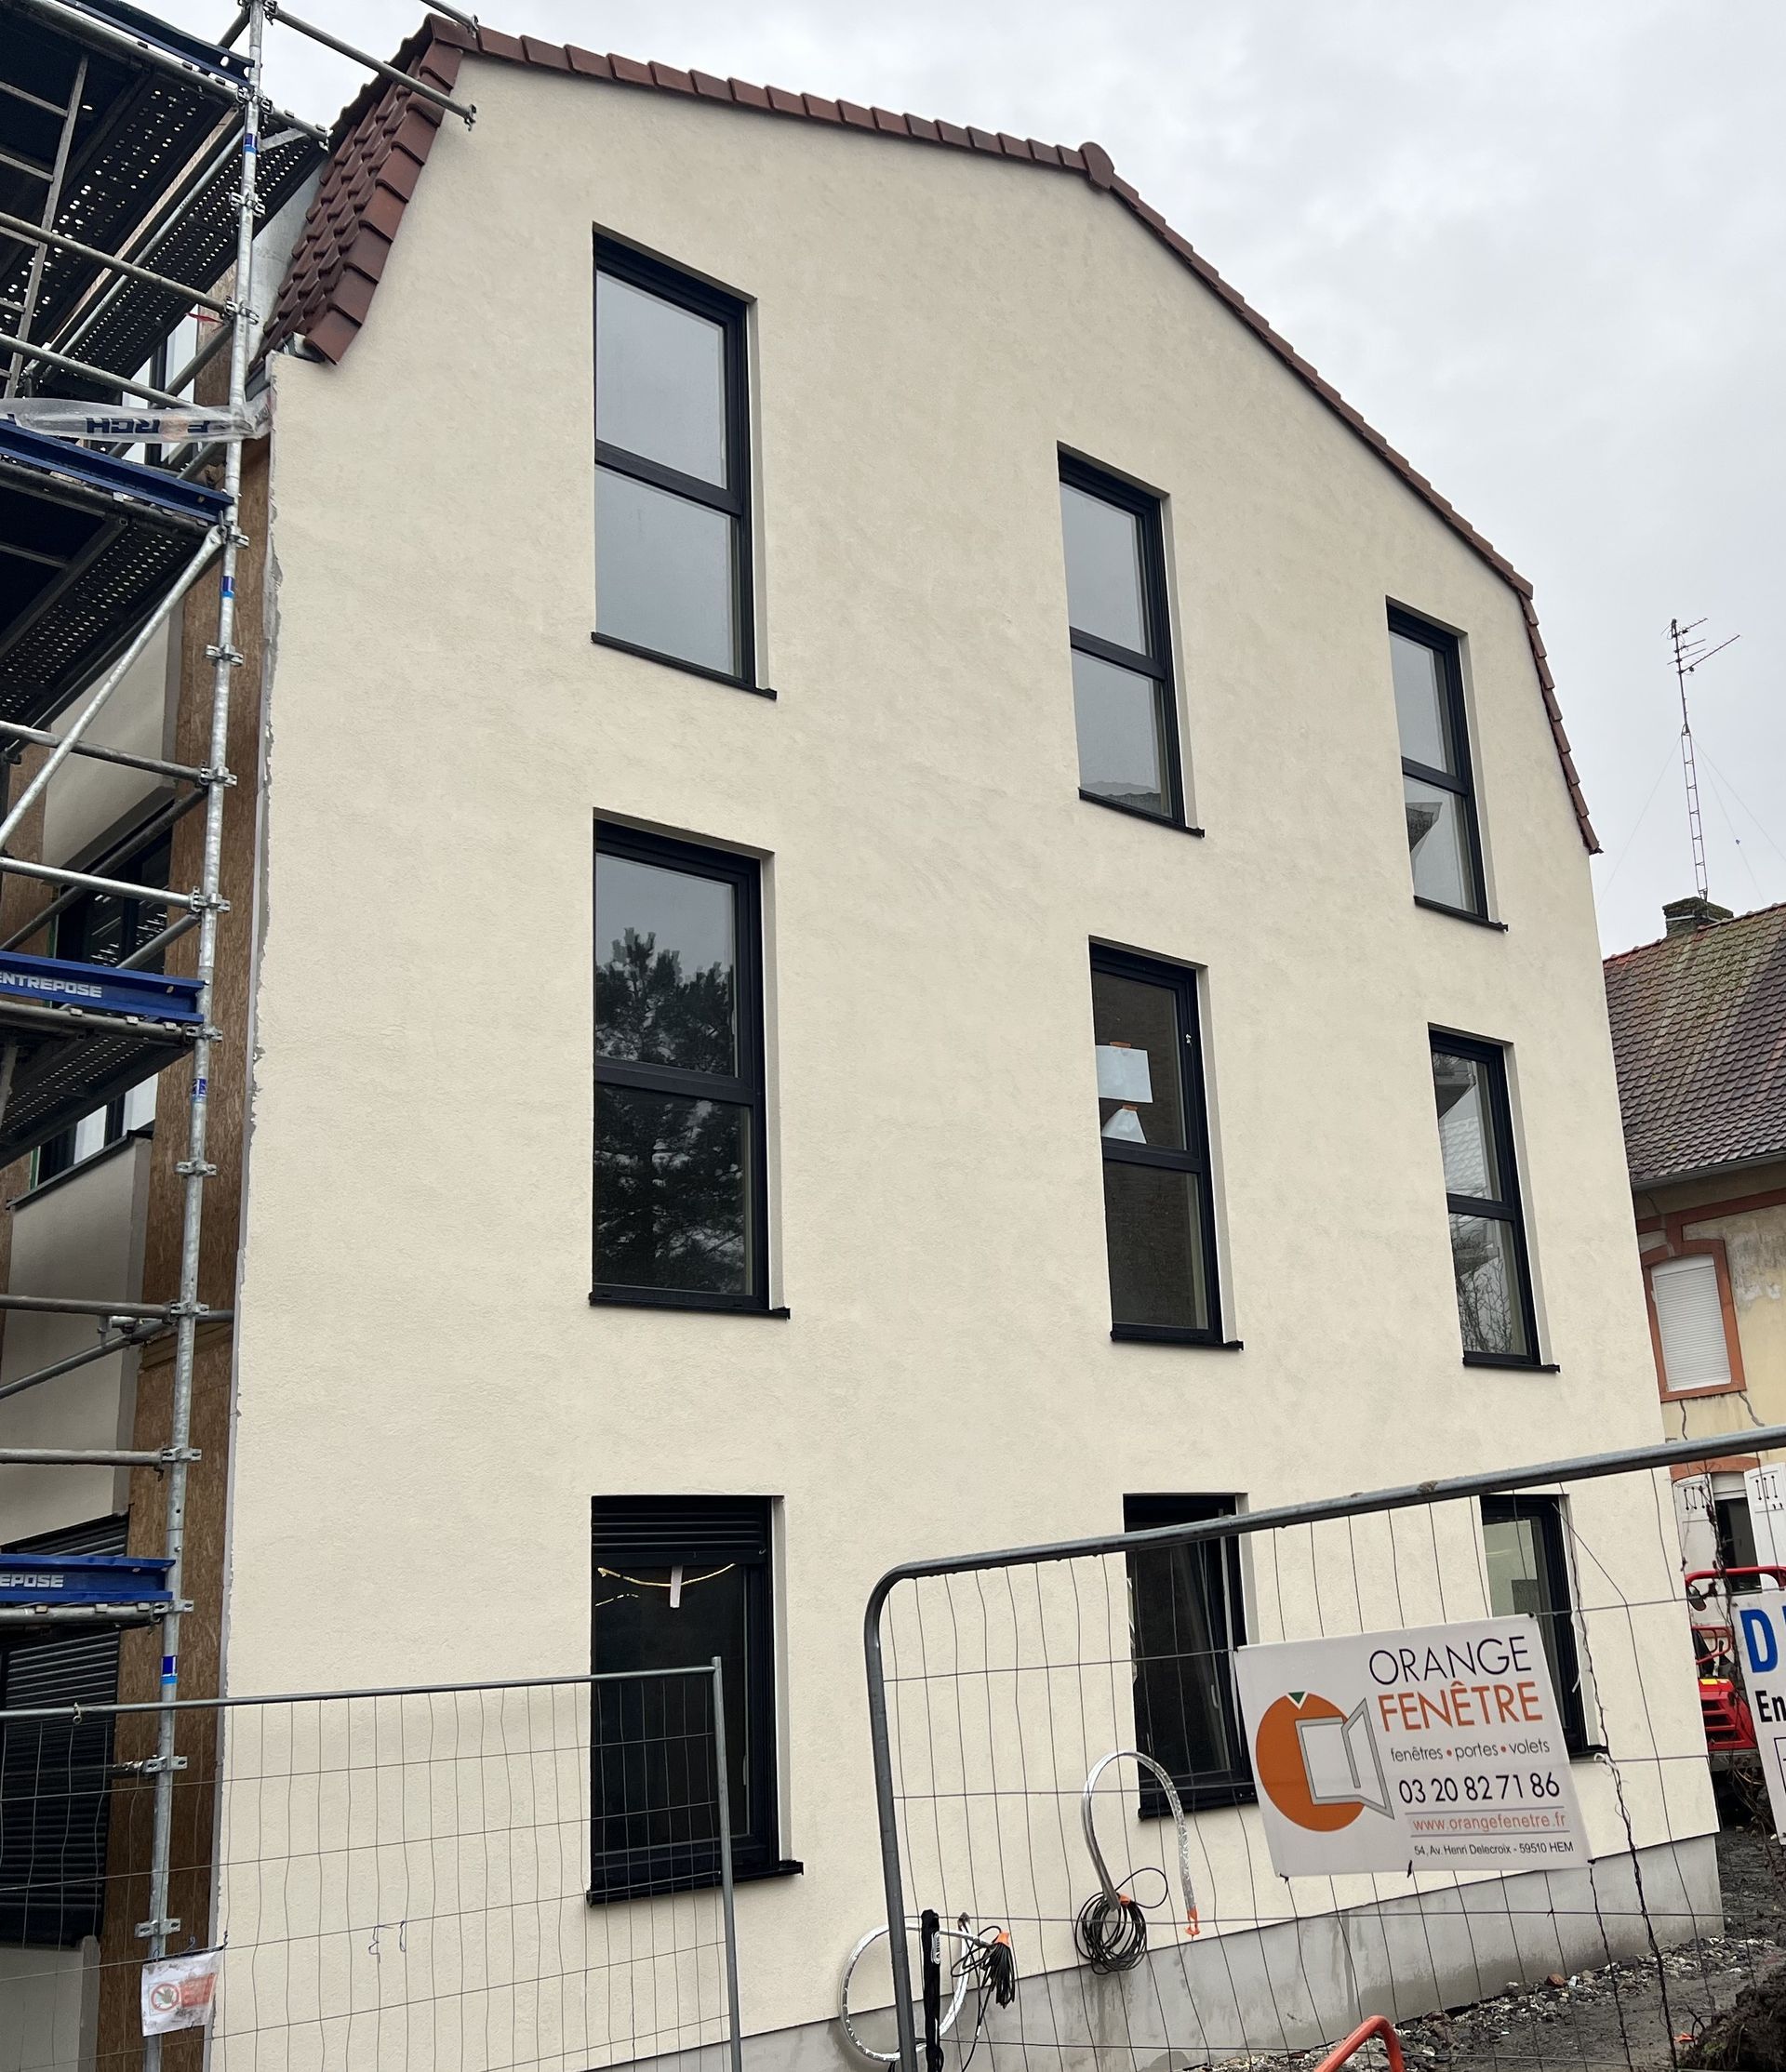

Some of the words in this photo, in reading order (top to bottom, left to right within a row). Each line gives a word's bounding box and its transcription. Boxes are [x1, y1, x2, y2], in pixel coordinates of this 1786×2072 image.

[86, 418, 210, 433] FRCH
[0, 971, 102, 998] NTREPOSE
[1369, 1636, 1532, 1685] ORANGE
[1378, 1680, 1543, 1733] FENÊTRE
[1391, 1747, 1444, 1762] fenêtres
[1454, 1742, 1499, 1761] portes
[1509, 1738, 1551, 1755] volets
[1399, 1779, 1426, 1804] 03
[1431, 1777, 1459, 1802] 20
[1463, 1775, 1493, 1801] 82
[1495, 1774, 1524, 1800] 71
[1529, 1771, 1560, 1799] 86
[1414, 1845, 1429, 1857] 54,
[1444, 1844, 1468, 1855] Henri
[1469, 1843, 1512, 1855] Delecroix
[1519, 1842, 1547, 1853] 59510
[1549, 1840, 1574, 1853] HEM
